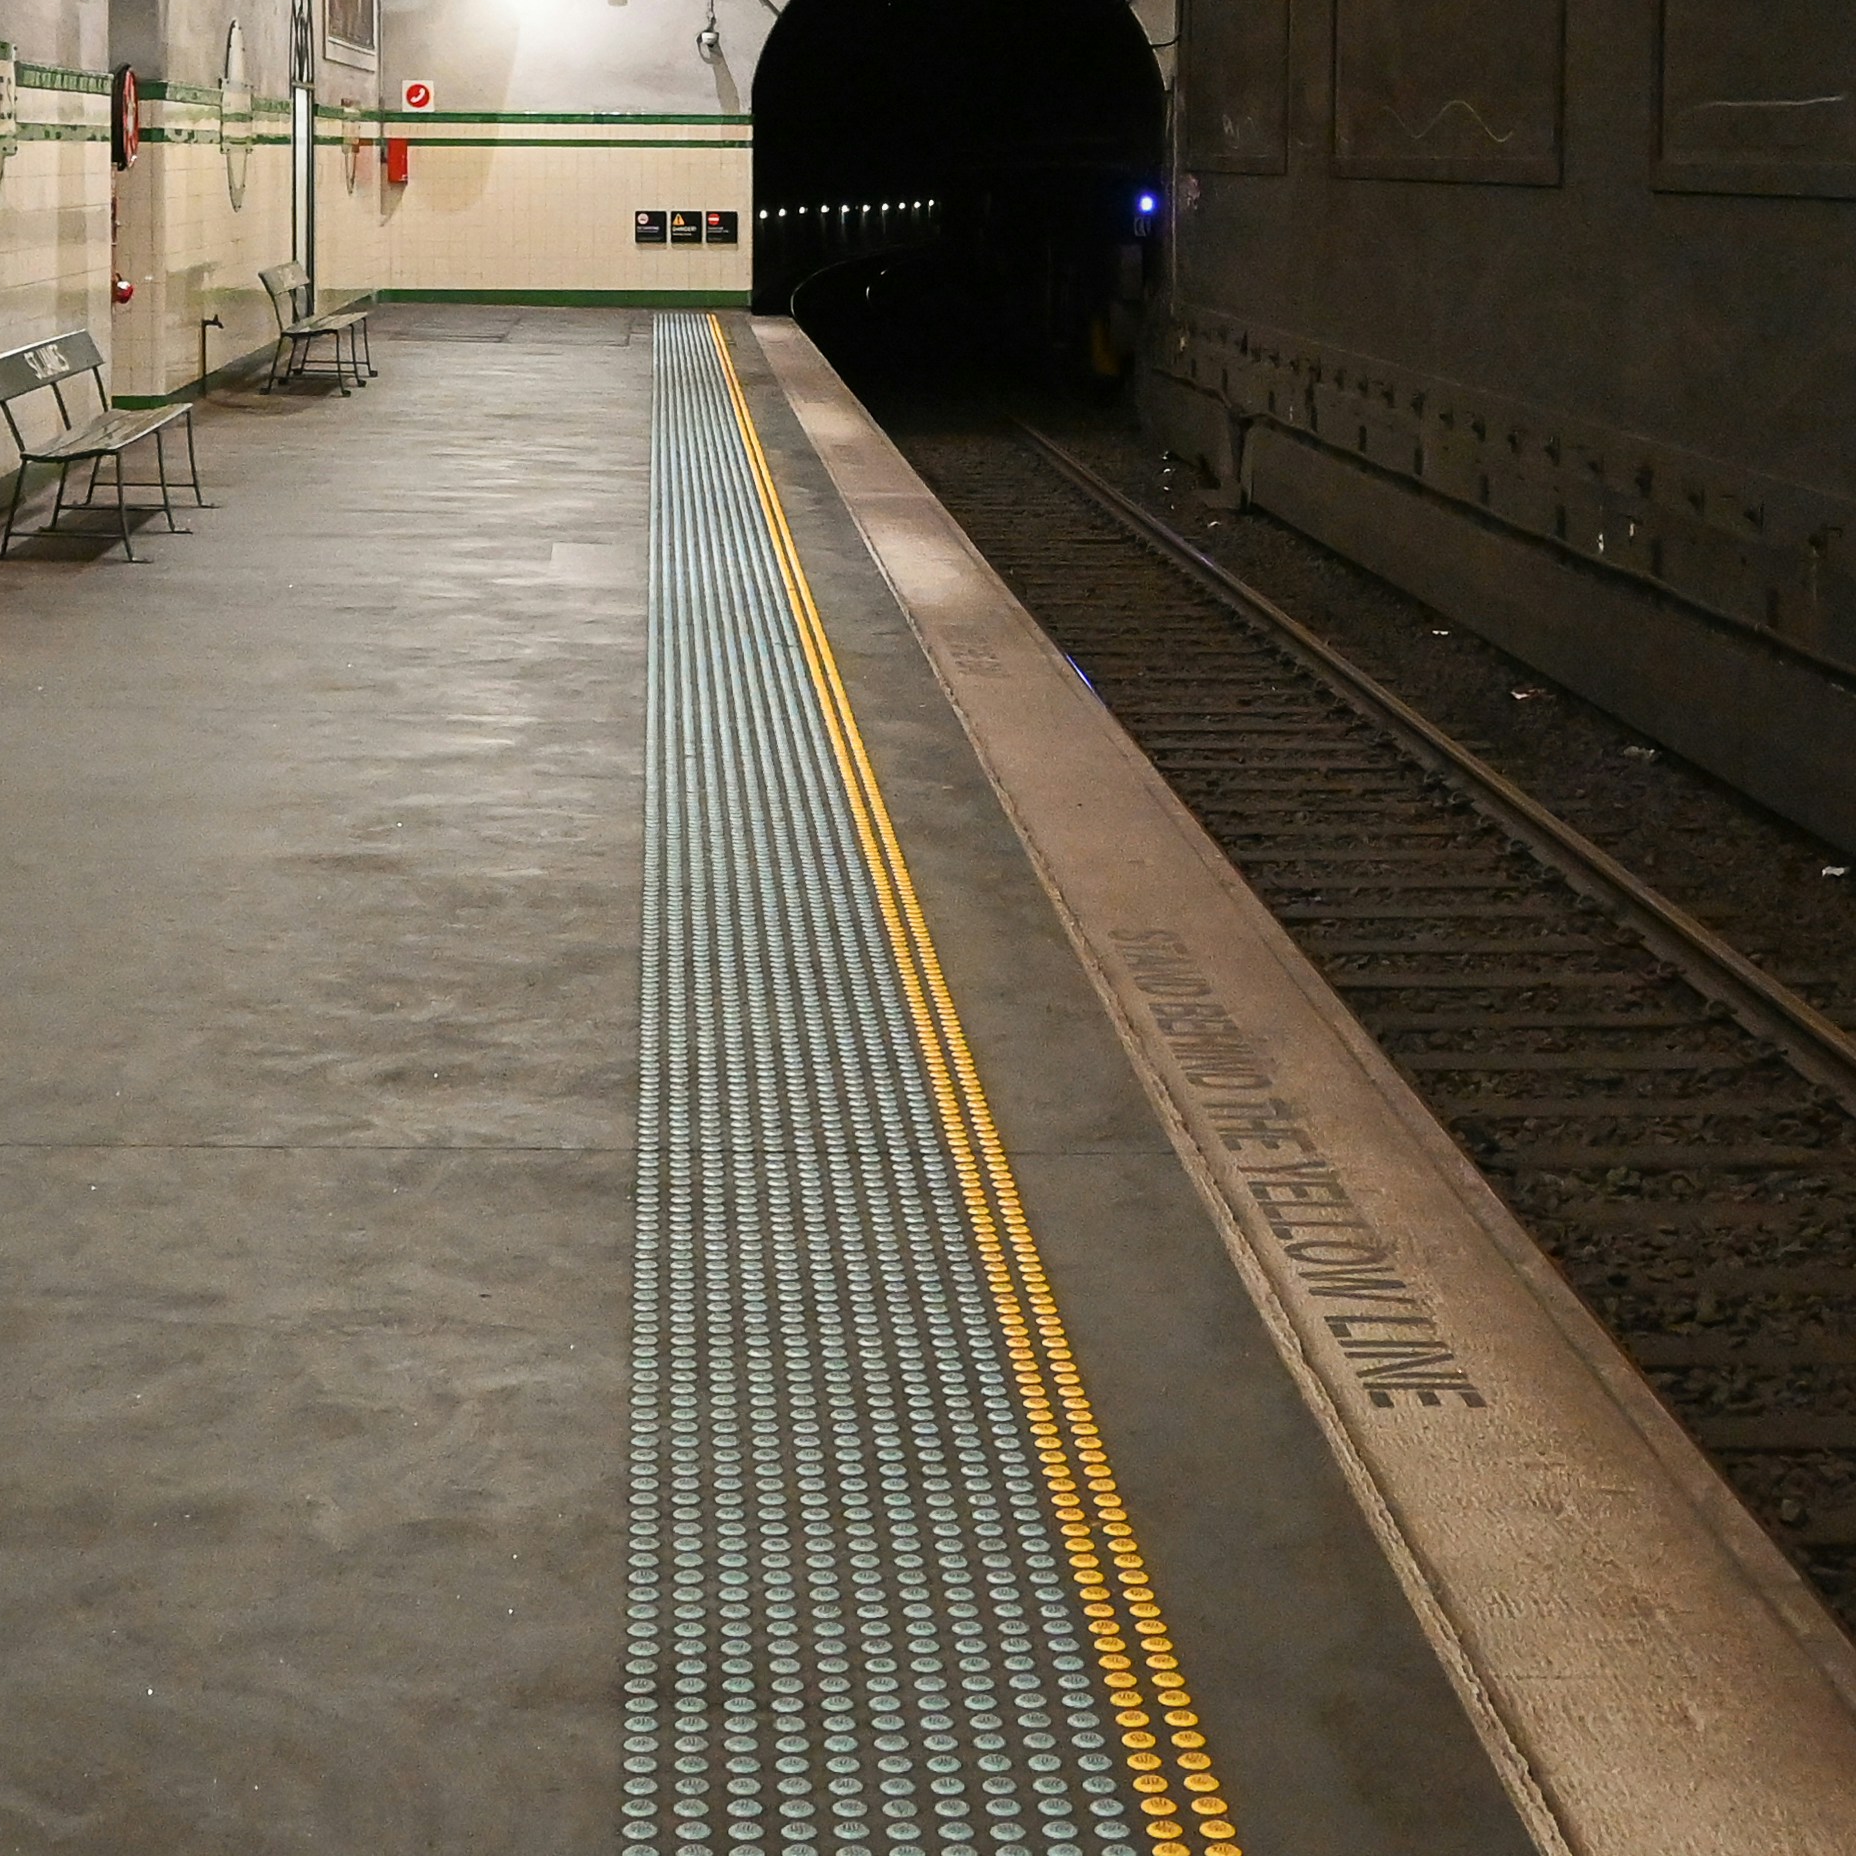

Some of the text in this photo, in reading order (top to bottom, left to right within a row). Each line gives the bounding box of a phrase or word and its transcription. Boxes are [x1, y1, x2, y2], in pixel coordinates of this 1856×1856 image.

[1148, 1002, 1273, 1090] BEHIND
[1202, 1097, 1318, 1154] THE
[1237, 1159, 1418, 1305] YELLOW
[1323, 1315, 1488, 1408] LINE
